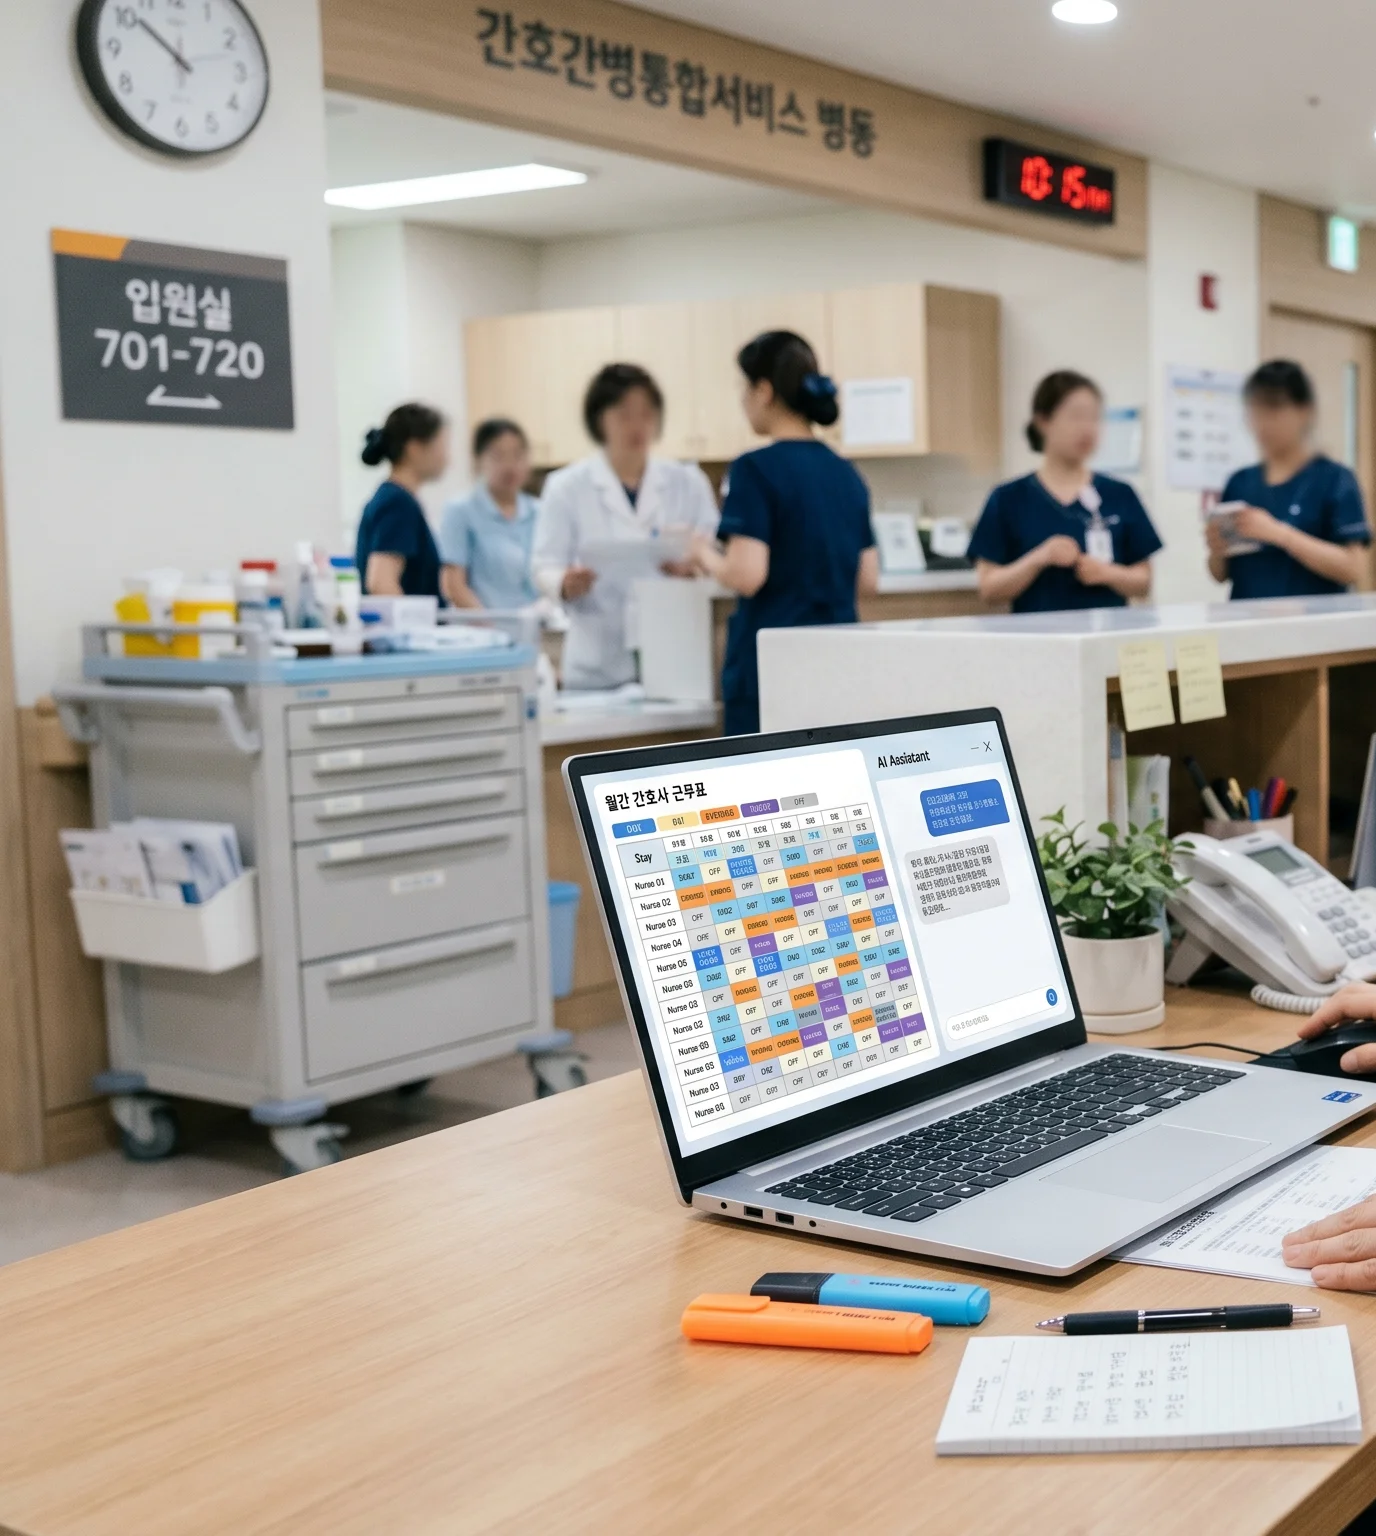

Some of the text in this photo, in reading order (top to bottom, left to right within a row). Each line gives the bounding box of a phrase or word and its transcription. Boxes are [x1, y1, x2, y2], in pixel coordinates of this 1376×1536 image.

[115, 5, 137, 30] 10
[106, 36, 121, 59] 9
[222, 26, 237, 49] 2
[118, 70, 133, 95] 8
[234, 60, 248, 84] 3
[476, 7, 877, 159] 간호간병통합서비스 병동
[144, 99, 157, 121] 7
[226, 93, 239, 111] 4
[174, 116, 189, 138] 6
[205, 111, 220, 135] 5
[125, 278, 233, 333] 입원실
[94, 327, 265, 380] 701-720
[877, 756, 888, 768] AI
[605, 782, 708, 812] 월간 간호사 근무표
[634, 853, 653, 864] Stay
[655, 877, 664, 886] 01
[672, 938, 682, 947] 04
